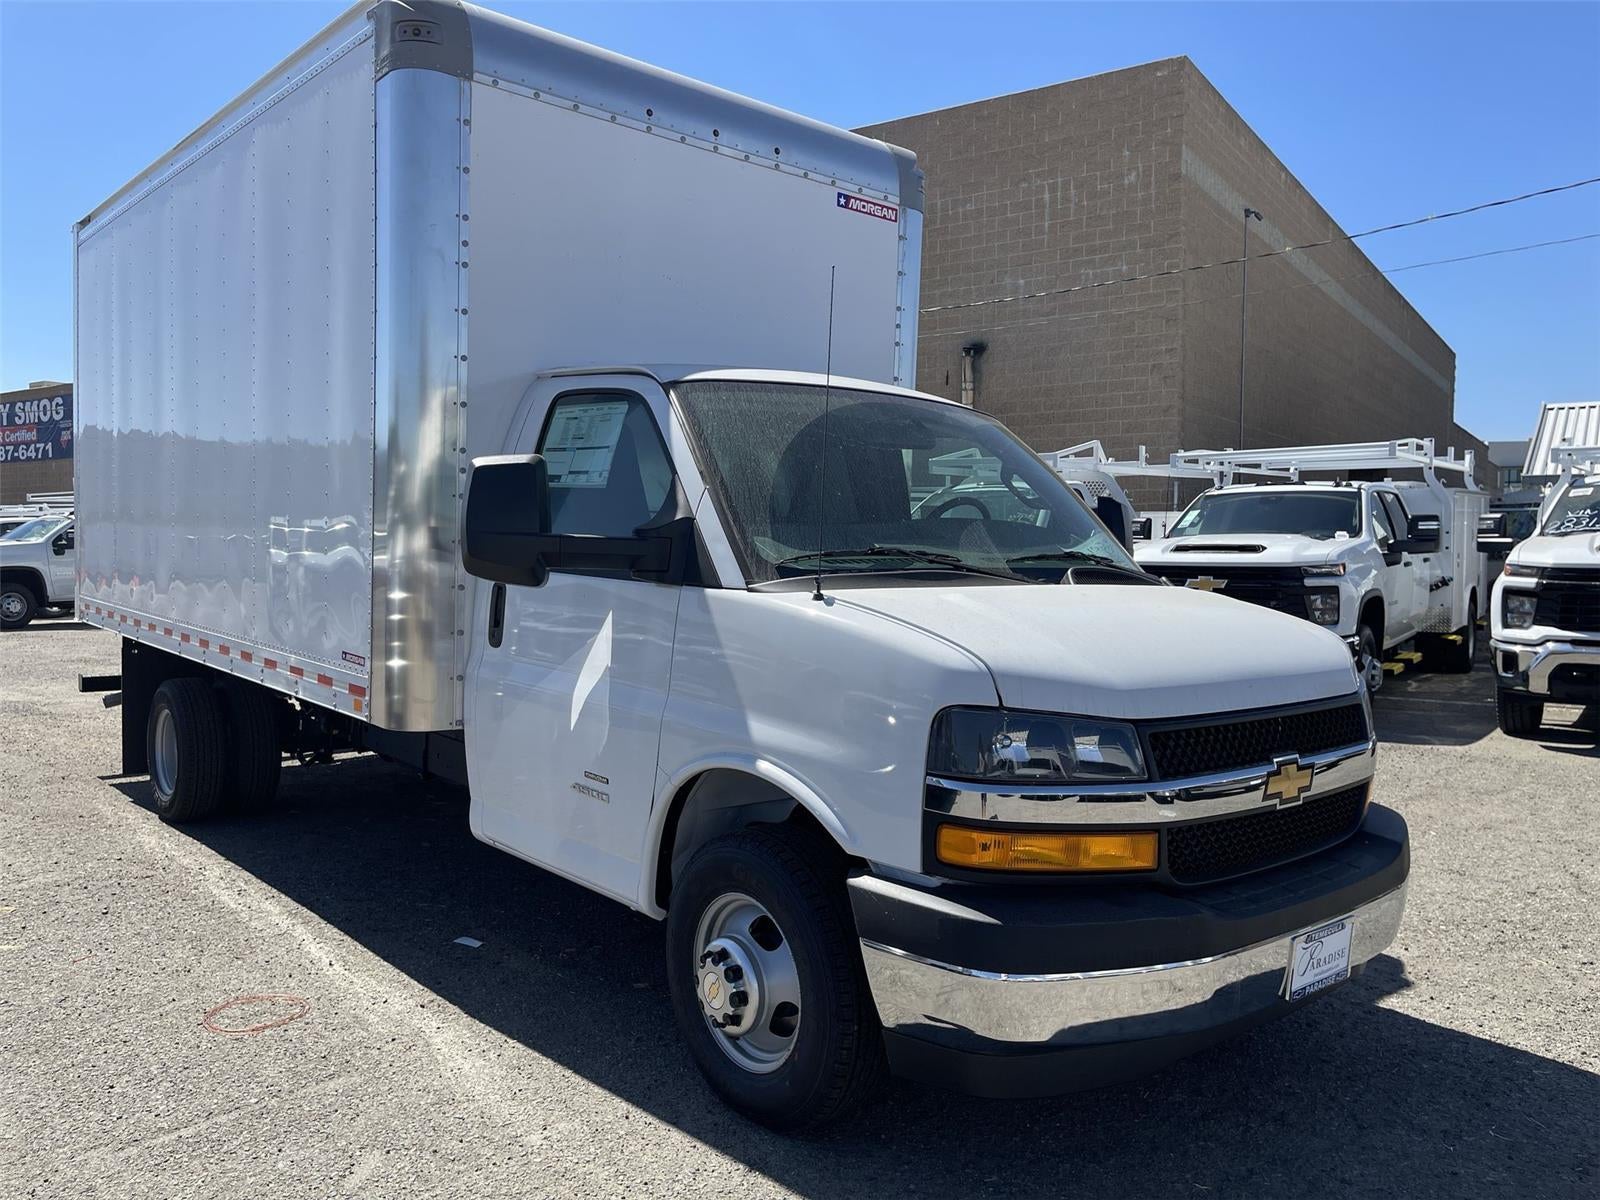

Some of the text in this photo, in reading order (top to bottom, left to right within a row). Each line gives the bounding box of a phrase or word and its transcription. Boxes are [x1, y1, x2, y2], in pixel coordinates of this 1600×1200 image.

[848, 198, 896, 220] MORGAN
[15, 397, 64, 425] SMOG
[5, 428, 37, 442] Certified
[0, 442, 53, 461] 87-6471
[1567, 508, 1598, 517] VIN
[1545, 517, 1600, 534] 2831
[1298, 941, 1347, 976] PARADISE
[1305, 975, 1337, 996] PARADISE
